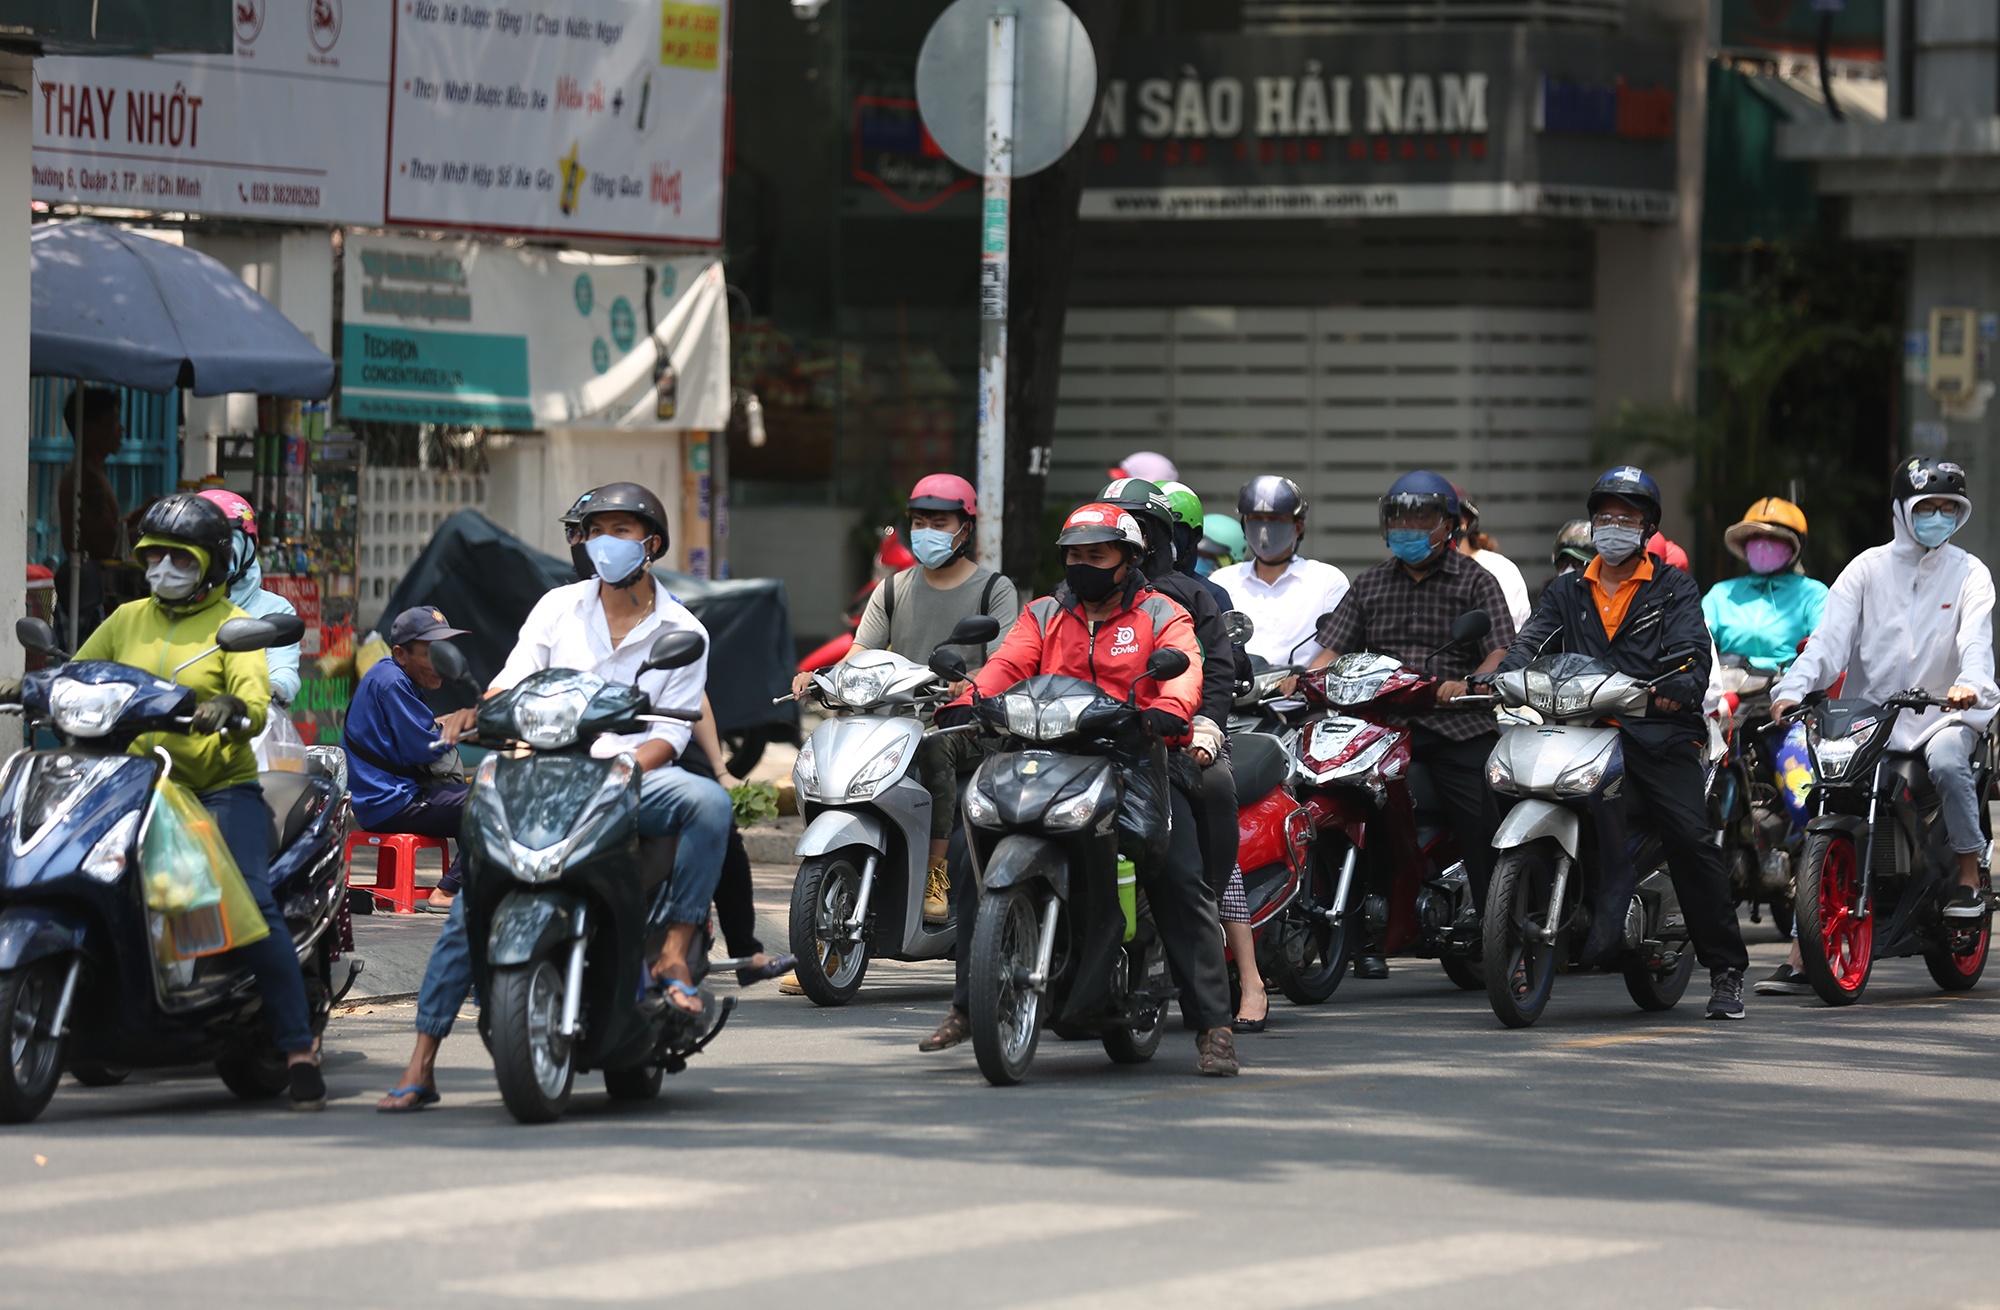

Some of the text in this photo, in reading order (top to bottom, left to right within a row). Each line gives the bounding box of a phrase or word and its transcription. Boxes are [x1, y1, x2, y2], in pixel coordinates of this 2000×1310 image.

[41, 81, 203, 148] THAY NHỚT
[1136, 62, 1243, 139] SÀO
[1254, 59, 1354, 137] HẢI
[1364, 72, 1490, 136] NAM
[176, 173, 202, 198] Minh
[914, 800, 931, 810] HONDA
